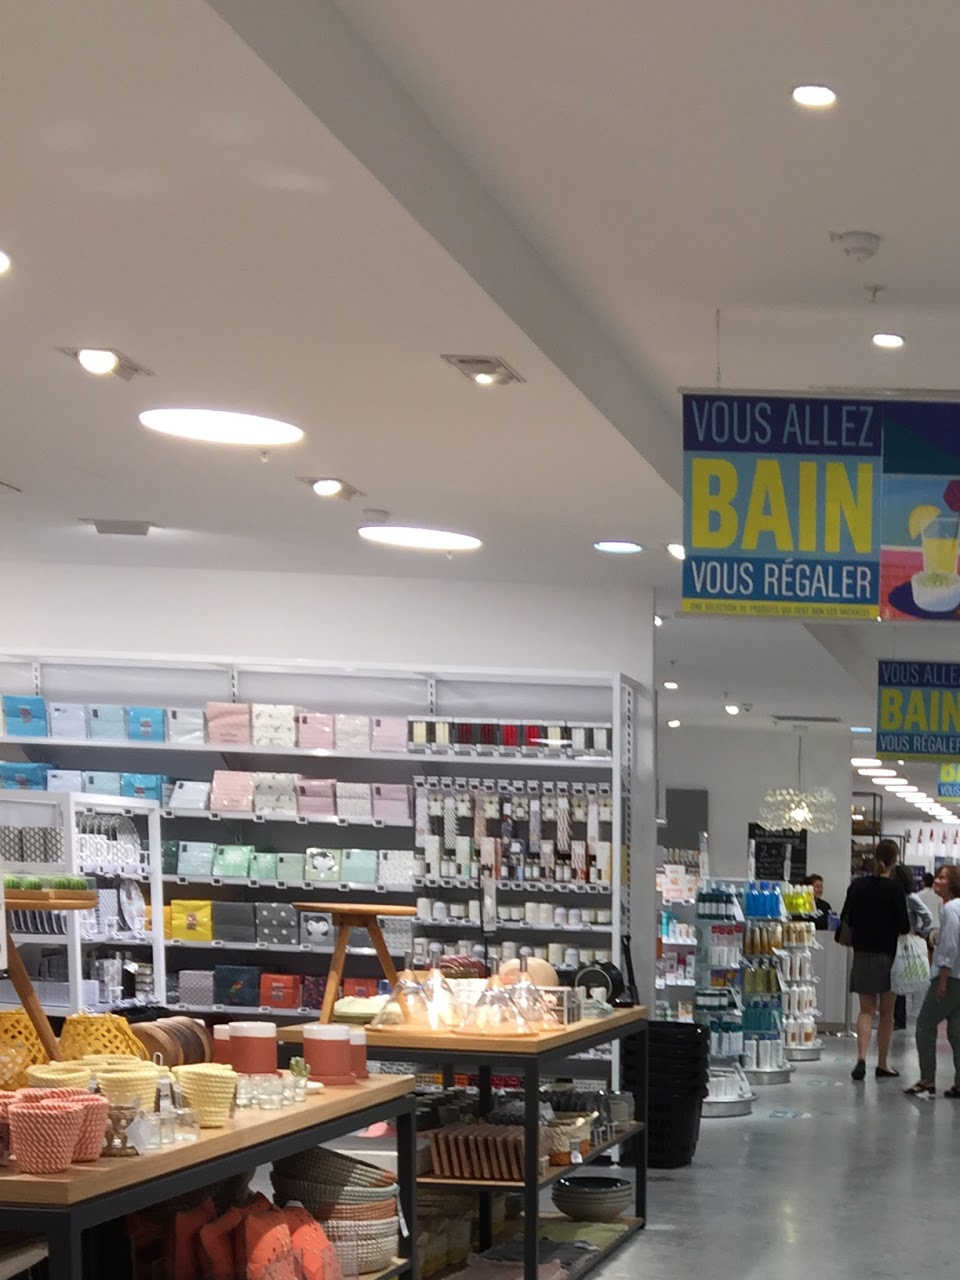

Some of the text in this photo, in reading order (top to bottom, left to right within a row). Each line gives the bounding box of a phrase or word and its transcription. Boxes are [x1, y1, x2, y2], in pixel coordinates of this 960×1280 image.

[691, 399, 875, 448] VOUS ALLEZ
[692, 459, 873, 554] BAIN
[691, 556, 872, 600] VOUS RÉGALER
[882, 663, 919, 684] VOUS
[879, 735, 910, 752] VOUS
[940, 784, 960, 797] VOUS
